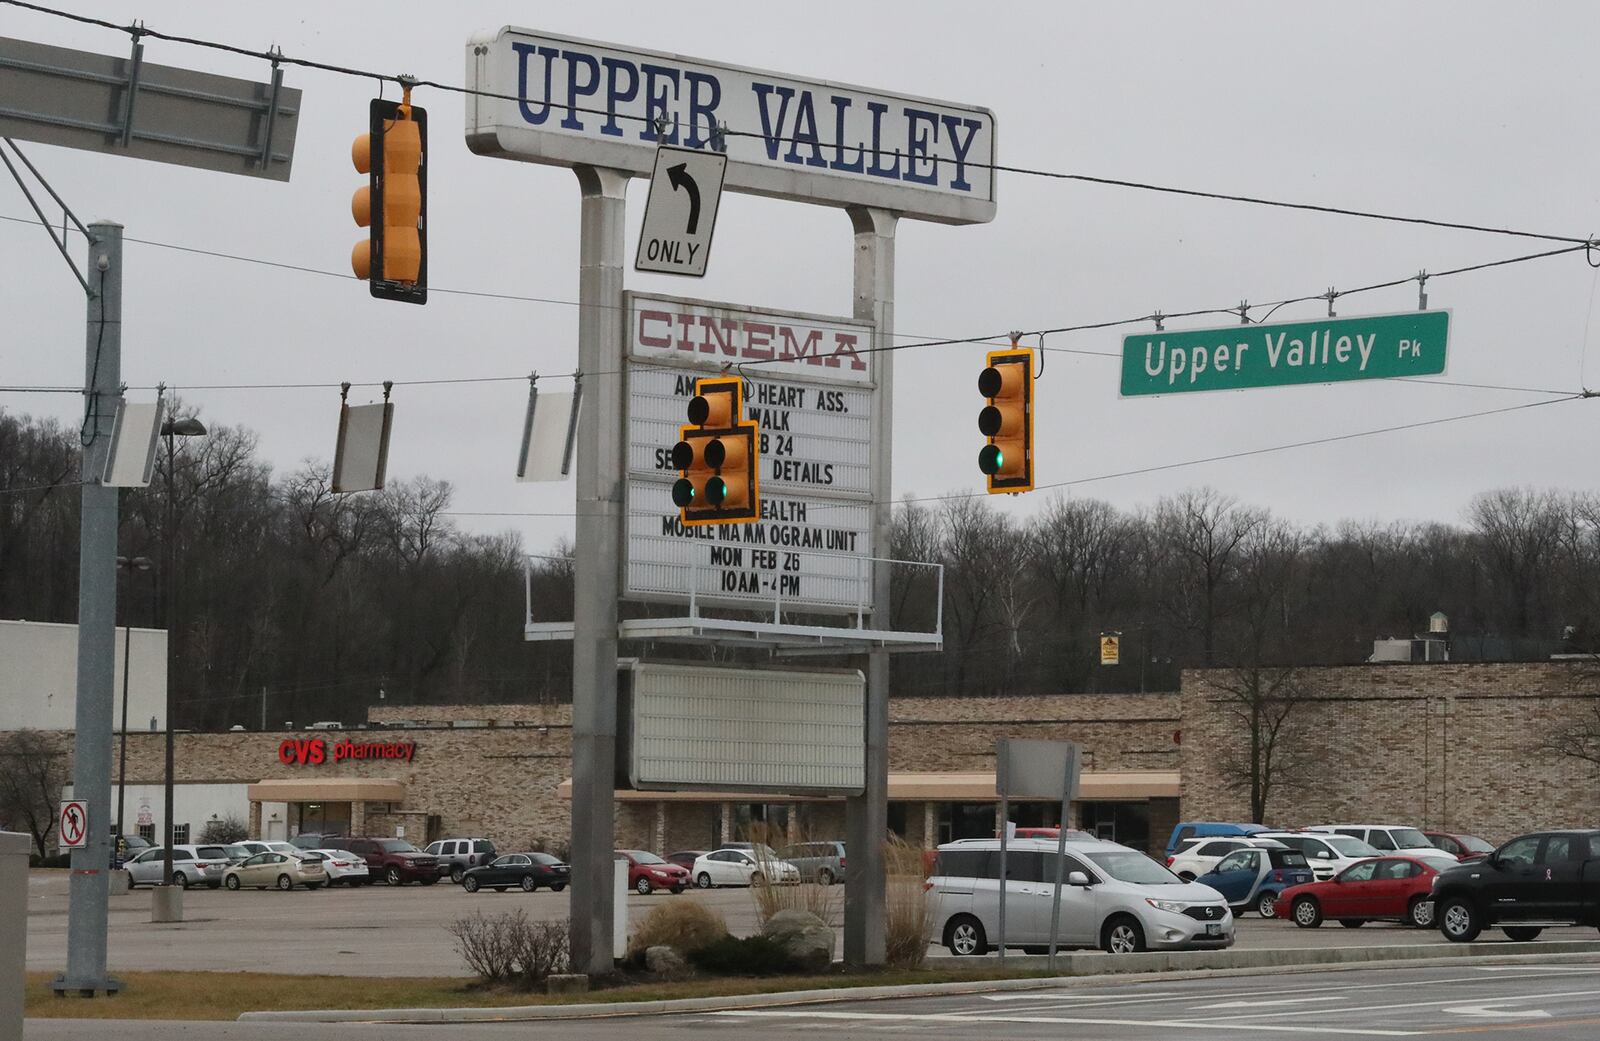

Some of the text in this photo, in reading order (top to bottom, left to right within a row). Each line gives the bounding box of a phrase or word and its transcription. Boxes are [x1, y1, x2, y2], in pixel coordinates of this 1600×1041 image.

[512, 42, 982, 191] UPPER VALLEY
[647, 238, 700, 265] ONLY
[639, 309, 867, 371] CINEMA
[1145, 329, 1421, 386] Upper Valley Pk
[758, 384, 806, 409] HEART
[817, 391, 849, 413] ASS.
[749, 407, 790, 431] WALK
[776, 436, 793, 456] 24
[655, 449, 834, 485] SE DETAILS
[761, 500, 806, 522] EALTH
[662, 516, 715, 540] MOBILE
[826, 531, 857, 551] UNIT
[710, 546, 800, 571] MON FEB 26
[279, 738, 417, 764] CVS pharmacy
